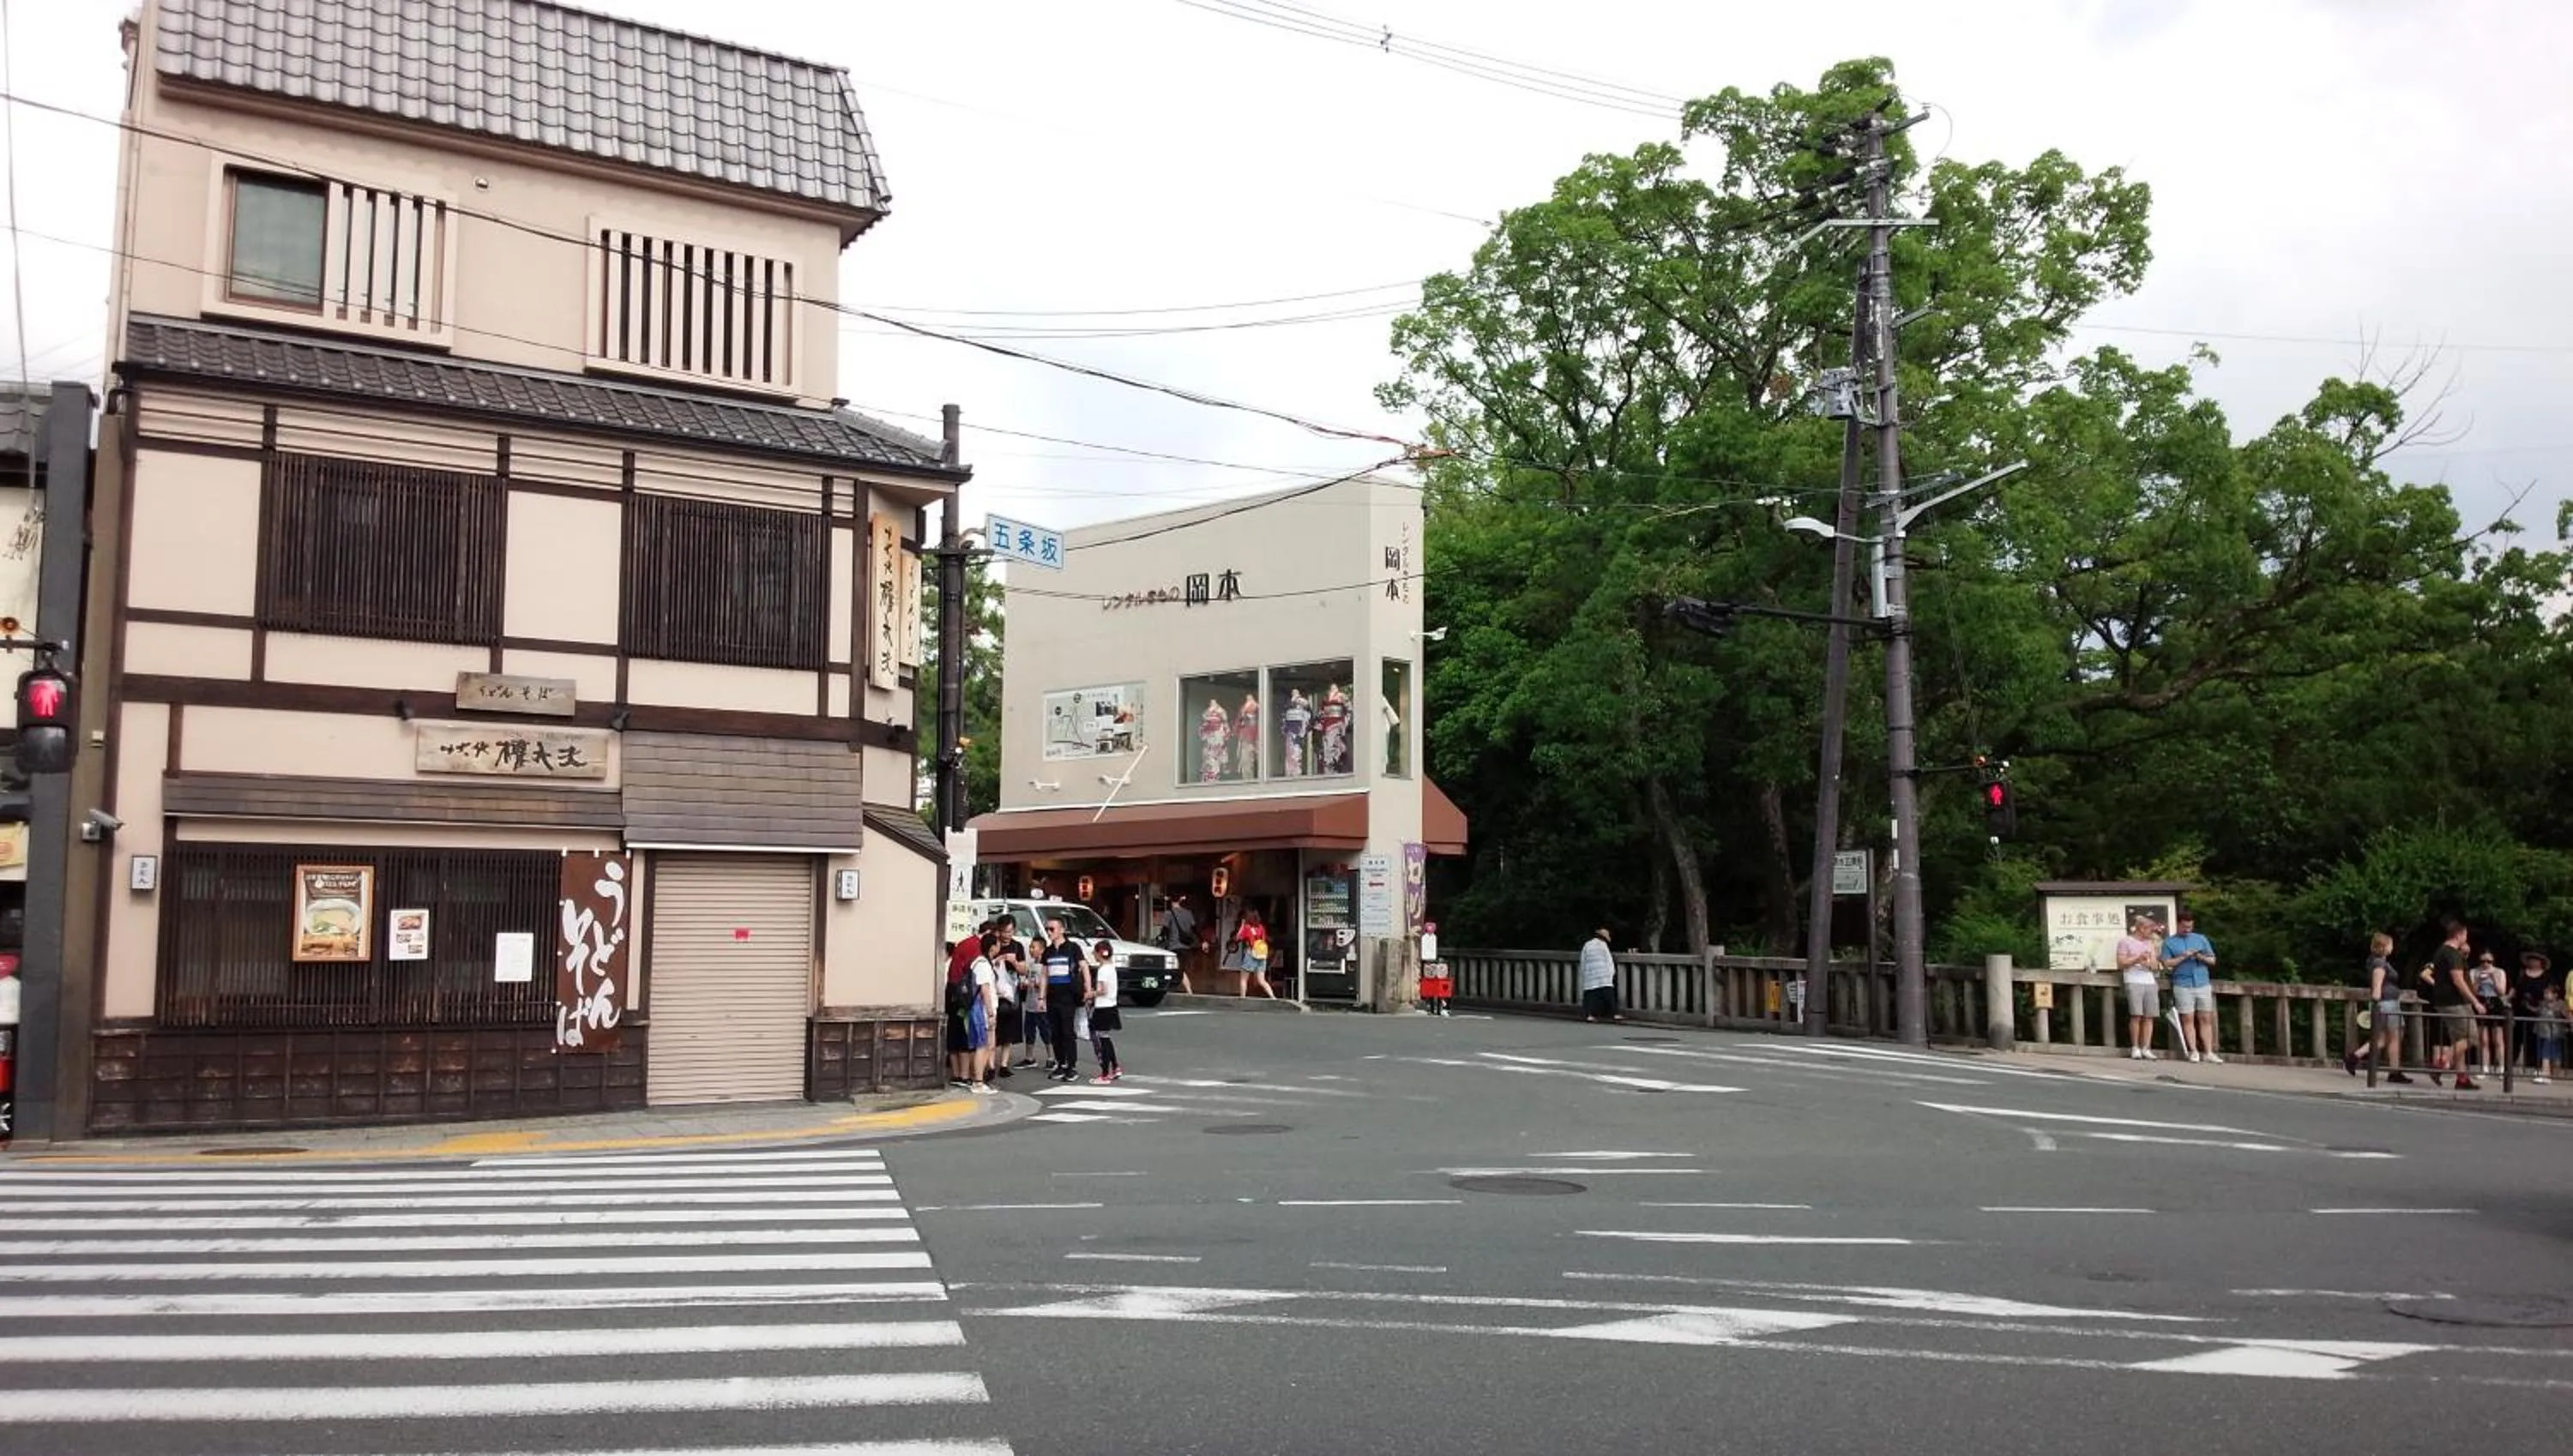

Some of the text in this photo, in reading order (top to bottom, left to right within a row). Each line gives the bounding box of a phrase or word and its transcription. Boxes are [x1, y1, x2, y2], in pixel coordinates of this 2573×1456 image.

[993, 521, 1058, 563] 五条坂
[1185, 569, 1243, 608] 岡本
[557, 899, 594, 1046] そば
[589, 861, 624, 1029] うどん
